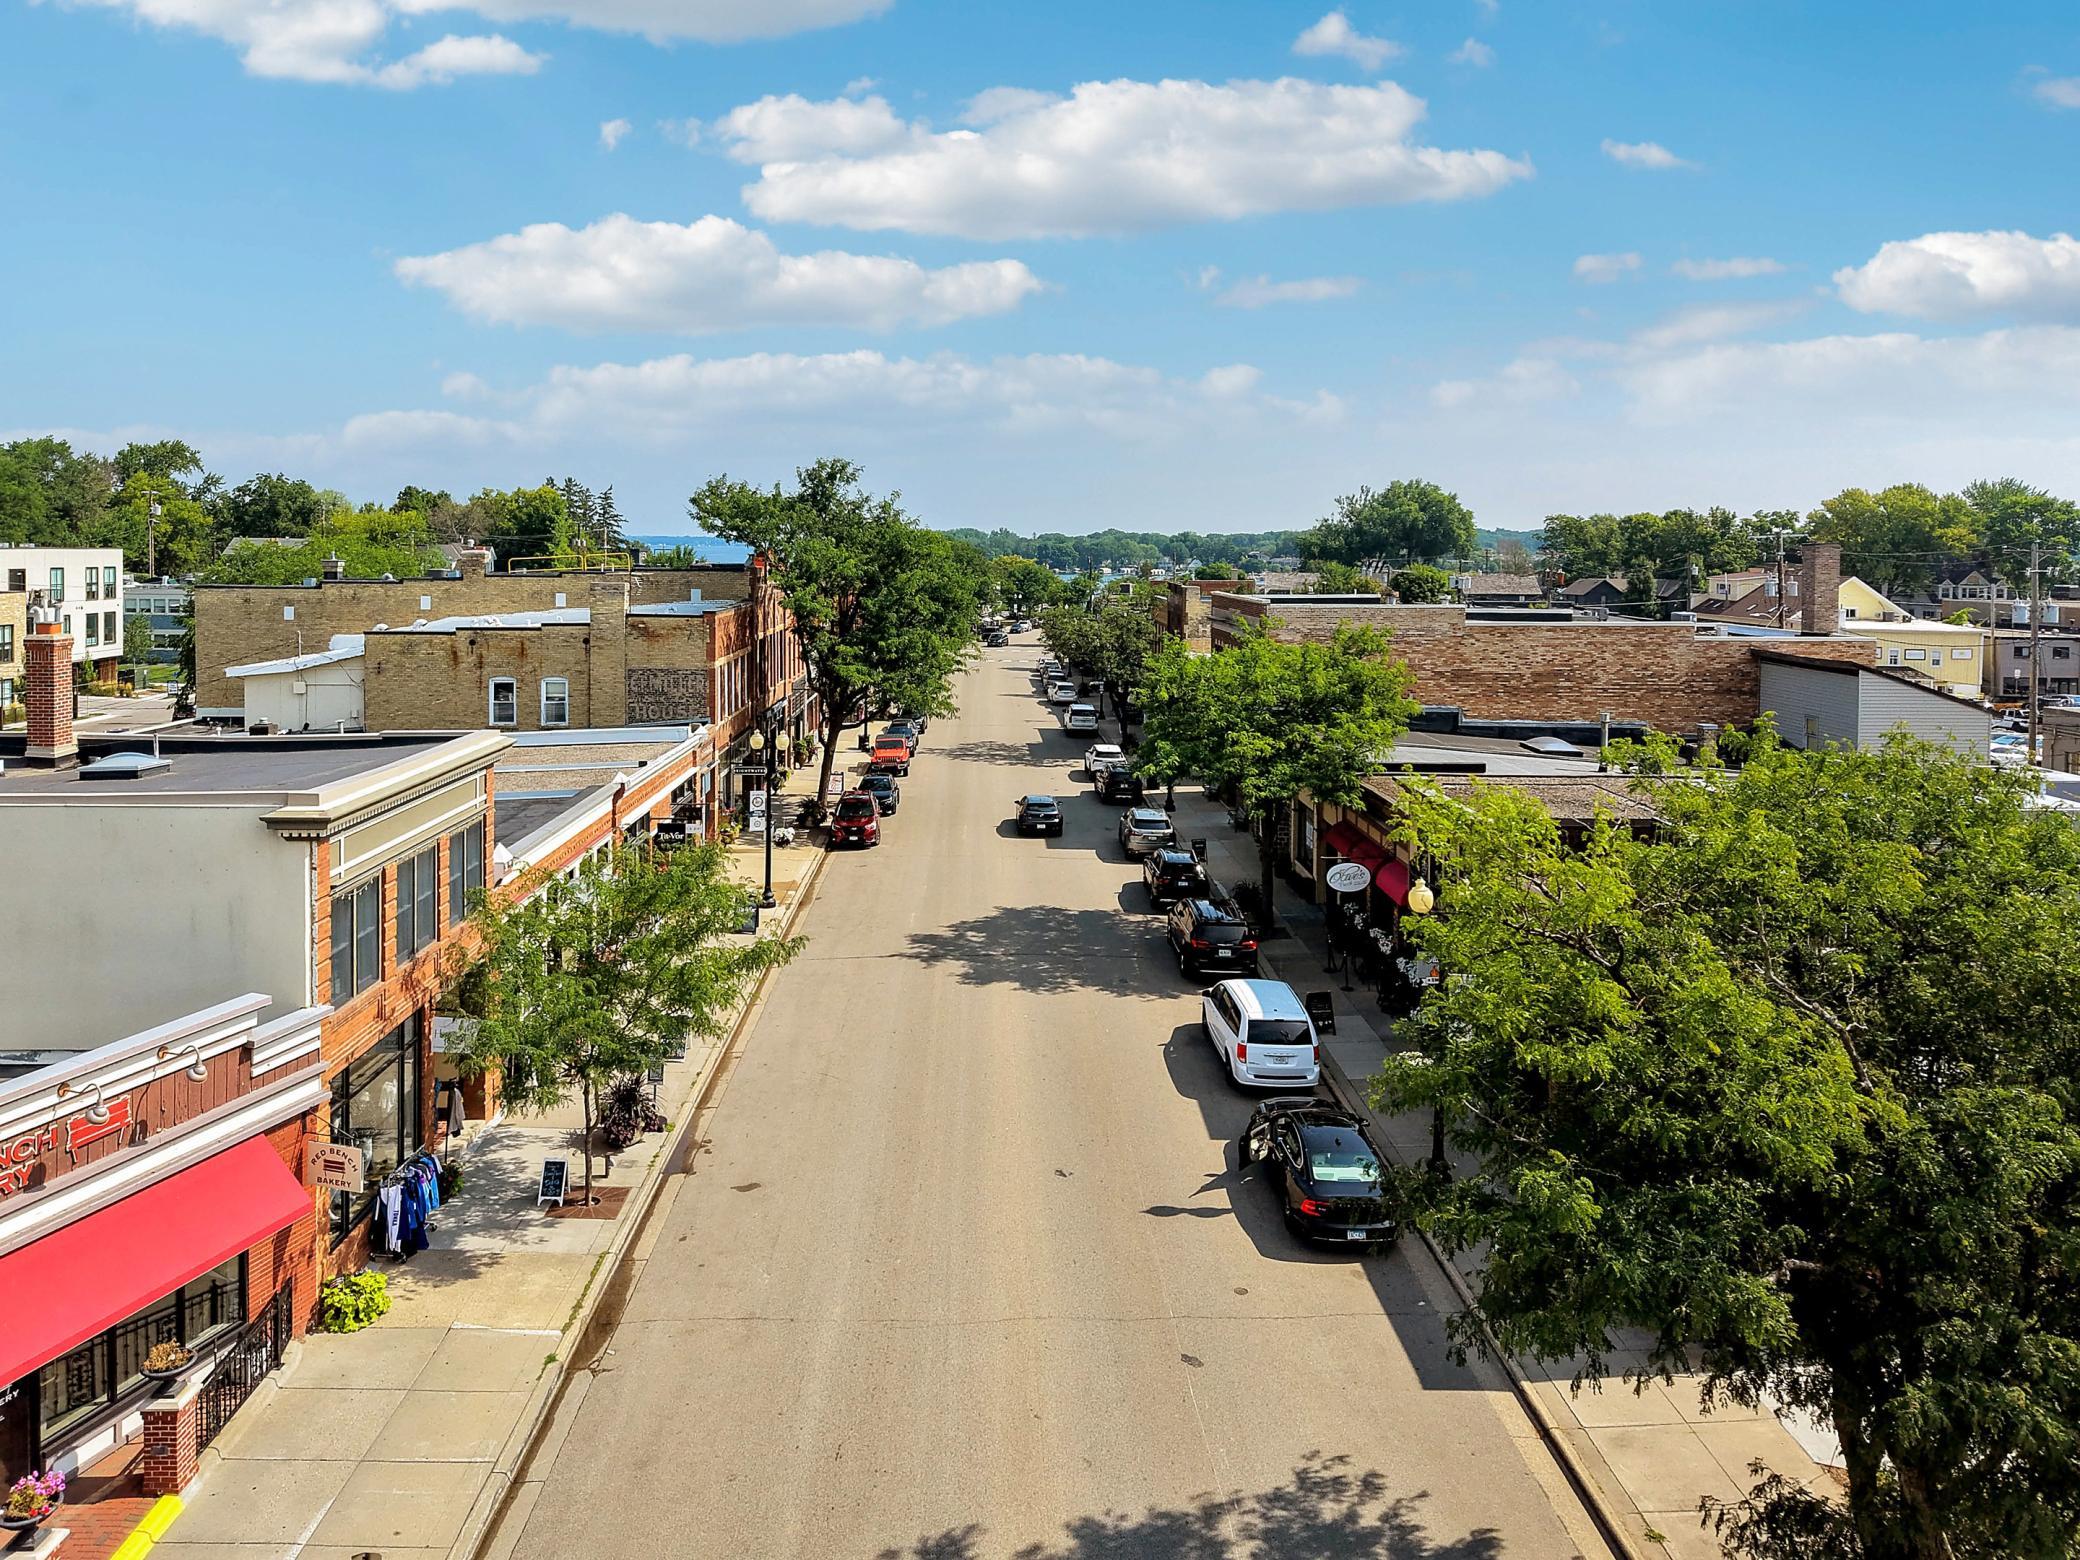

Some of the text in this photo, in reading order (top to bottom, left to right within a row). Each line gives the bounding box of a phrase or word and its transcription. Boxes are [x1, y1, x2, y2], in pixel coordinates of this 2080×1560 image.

[310, 1147, 359, 1173] RED BENCH
[316, 1176, 352, 1188] BAKERY
